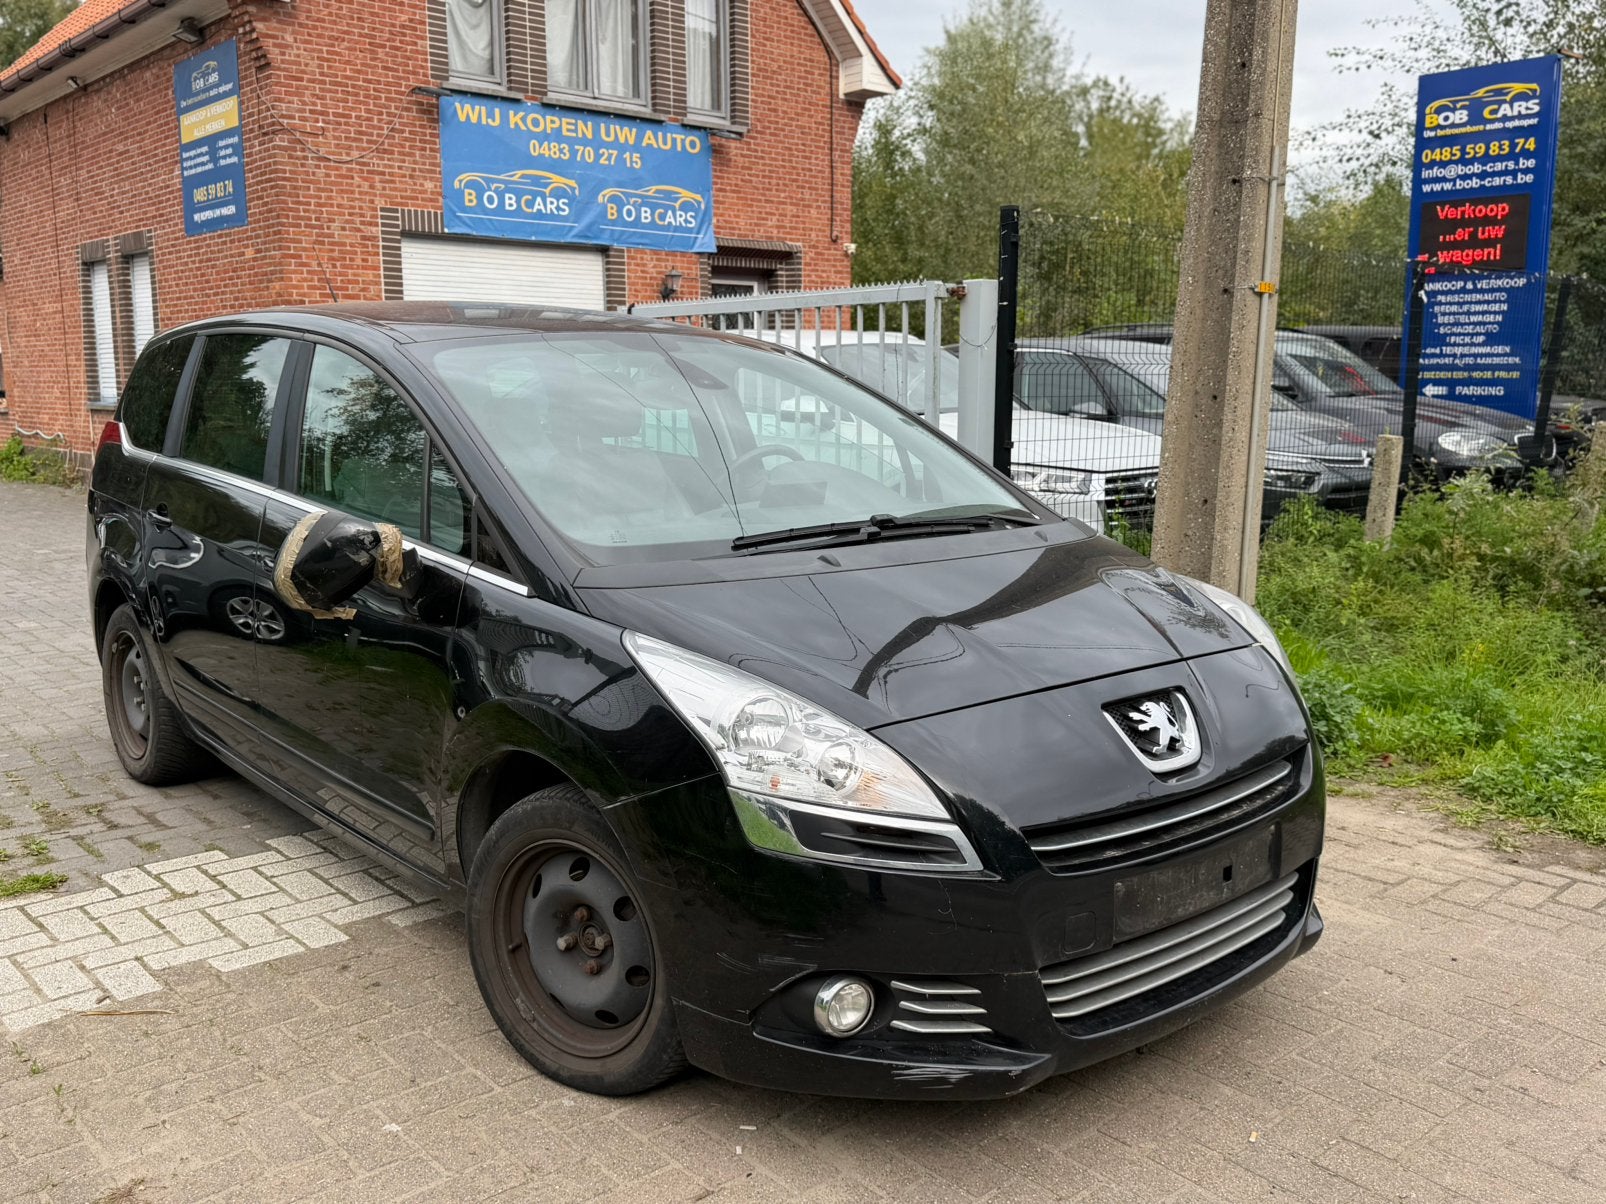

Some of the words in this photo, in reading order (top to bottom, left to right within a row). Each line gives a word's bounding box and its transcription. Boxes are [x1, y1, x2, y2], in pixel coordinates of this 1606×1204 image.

[205, 72, 219, 86] CARS
[184, 109, 206, 126] AANKOOP
[211, 100, 234, 117] VERKOOP
[1424, 109, 1469, 128] BOB
[1482, 99, 1541, 119] CARS
[194, 124, 206, 136] ALLE
[206, 118, 225, 133] MERKEN
[455, 102, 501, 127] WIJ
[508, 110, 593, 140] KOPEN
[600, 123, 637, 146] UW
[641, 129, 701, 155] AUTO
[1423, 130, 1436, 139] Uw
[1436, 124, 1485, 137] betrouwbare
[1485, 121, 1504, 130] auto
[1504, 118, 1539, 129] opkoper
[529, 139, 571, 161] 0483
[574, 144, 595, 163] 70
[599, 148, 617, 166] 27
[623, 151, 642, 169] 15
[1422, 146, 1461, 163] 0485
[1464, 143, 1486, 159] 59
[1489, 140, 1510, 156] 83
[1514, 137, 1537, 153] 74
[1421, 157, 1536, 179] info@bob-cars.be
[193, 186, 207, 203] 0485
[208, 183, 216, 200] 59
[216, 181, 225, 198] 83
[225, 179, 233, 196] 74
[1422, 172, 1534, 193] www.bob-cars.be
[193, 212, 201, 224] WIJ
[201, 209, 213, 221] KOPEN
[213, 207, 220, 218] UW
[220, 204, 236, 216] WAGEN
[1436, 203, 1510, 220] Verkoop
[1478, 225, 1506, 239] uw
[1438, 244, 1502, 266] wagen!
[1424, 281, 1464, 292] ANKOOP
[1466, 281, 1473, 289] &
[1475, 278, 1527, 290] VERKOOP
[1441, 345, 1511, 355] TERREINWAGEN
[1455, 385, 1505, 396] PARKING
